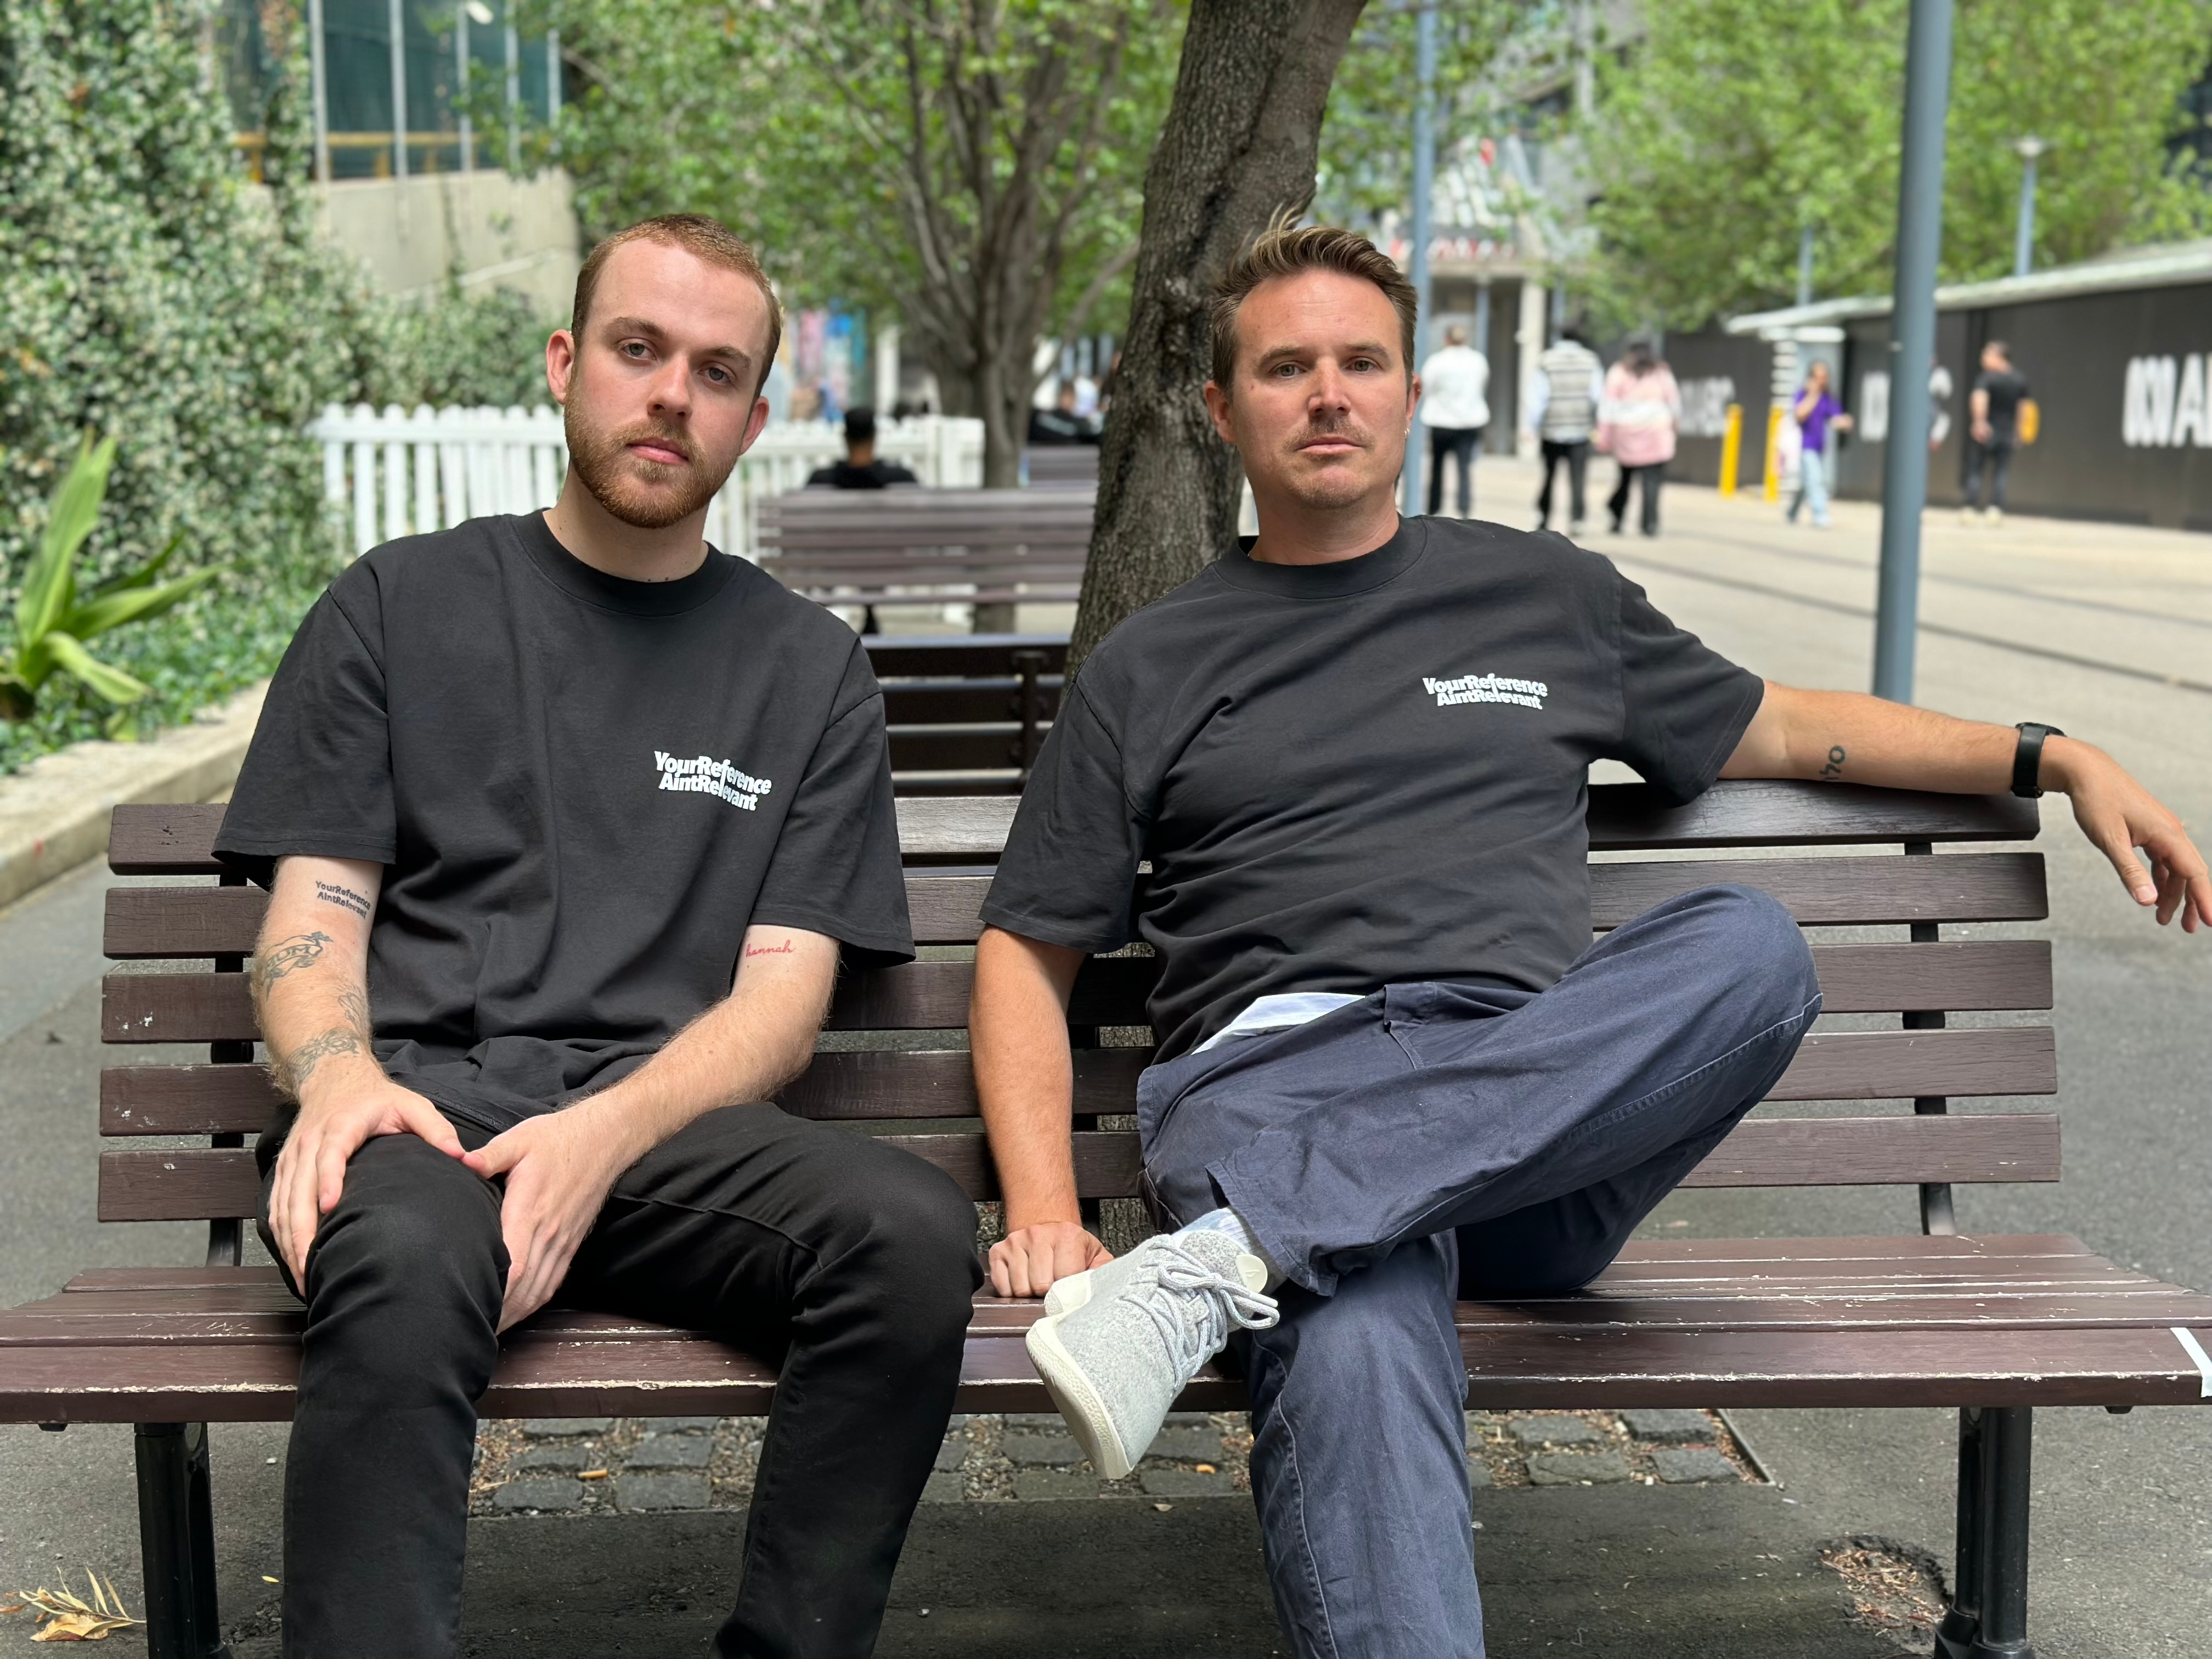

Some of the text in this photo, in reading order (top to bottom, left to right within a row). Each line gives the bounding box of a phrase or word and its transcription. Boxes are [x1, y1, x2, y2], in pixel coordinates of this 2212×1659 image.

[1423, 673, 1548, 697] YourReference
[1437, 689, 1543, 709] AintRelevant
[654, 751, 772, 794] YourReference
[658, 772, 758, 811] AintRelevant
[315, 880, 371, 910] YourReference
[746, 939, 794, 957] hannah
